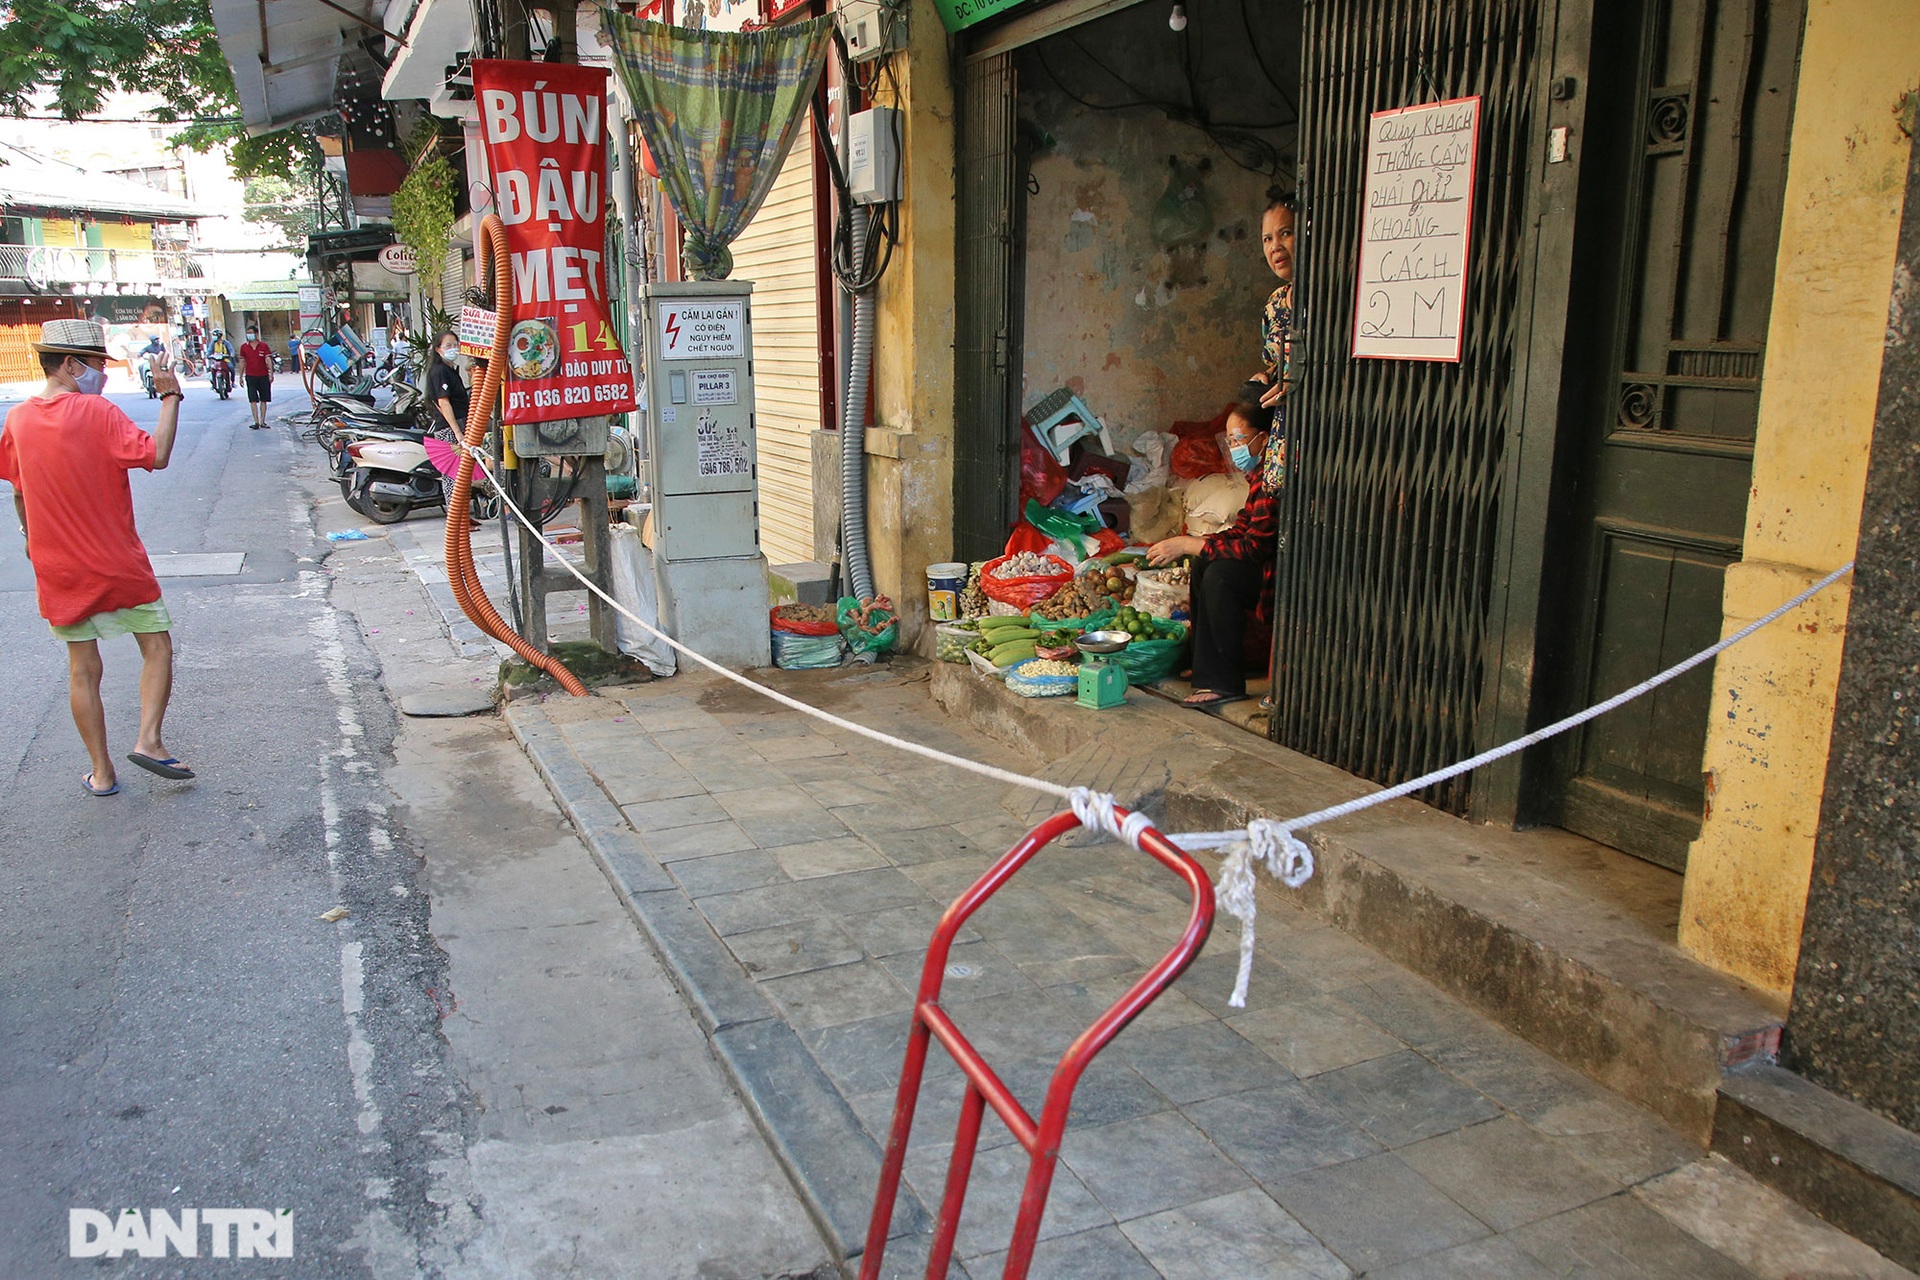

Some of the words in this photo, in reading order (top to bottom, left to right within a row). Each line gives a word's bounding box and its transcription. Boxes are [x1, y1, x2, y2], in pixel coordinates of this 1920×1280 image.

[482, 81, 600, 145] BÚN
[1424, 106, 1473, 135] KHÁCH
[1376, 143, 1426, 173] THÔNG
[1430, 133, 1469, 166] CẢM
[496, 158, 599, 232] ĐẬU
[1370, 206, 1439, 240] KHOẢNG
[1380, 242, 1448, 282] CÁCH
[510, 246, 600, 313] MẸT
[708, 322, 726, 332] ĐIỆN
[1361, 290, 1394, 336] 2
[1412, 287, 1446, 337] M
[566, 320, 619, 353] 14
[687, 342, 708, 352] CHẾT
[690, 334, 711, 342] NGUY
[712, 331, 732, 342] HIỂM
[565, 359, 588, 378] ĐÀO
[591, 359, 612, 376] DUY
[510, 391, 530, 409] ĐT:
[534, 388, 560, 407] 036
[564, 386, 590, 404] 820
[594, 383, 629, 402] 6582
[699, 382, 724, 390] PILLAR
